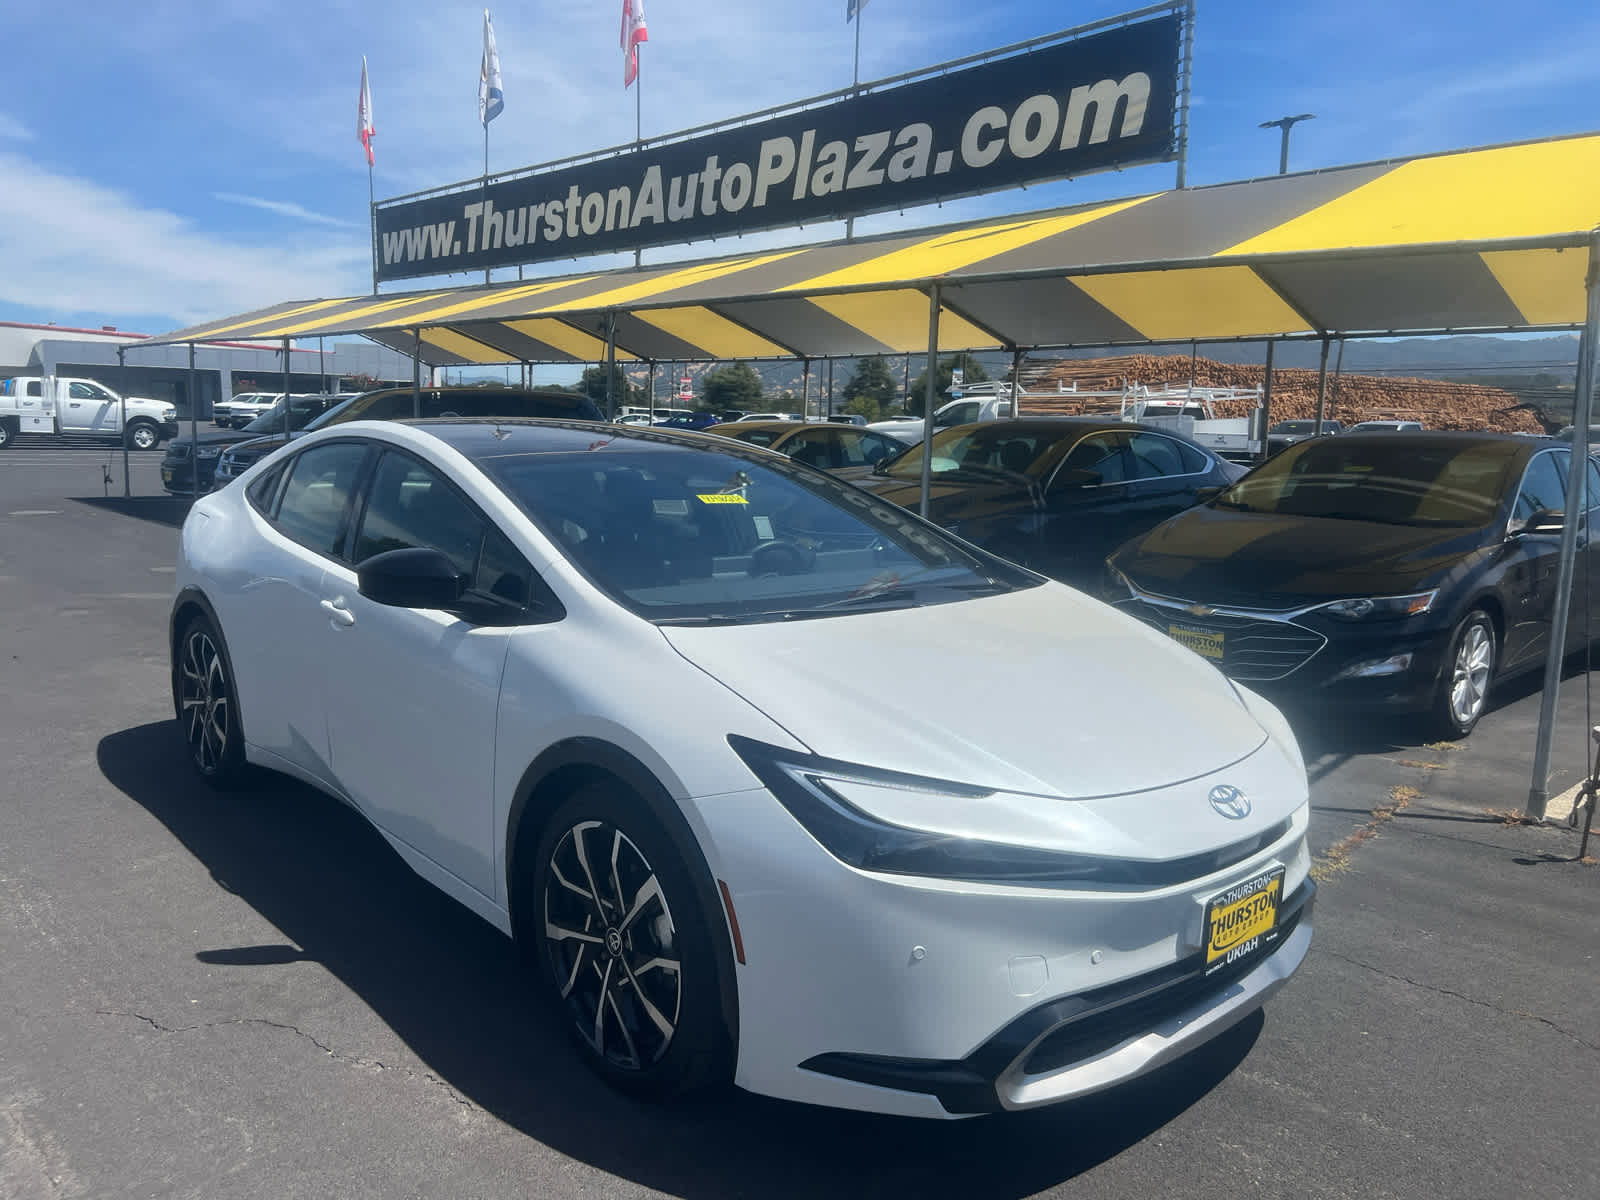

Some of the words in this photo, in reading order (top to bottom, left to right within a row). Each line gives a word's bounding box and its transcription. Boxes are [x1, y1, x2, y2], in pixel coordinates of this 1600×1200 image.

[382, 71, 1151, 265] www.ThurstonAutoPlaza.com
[1227, 875, 1270, 903] THURSTON
[1209, 889, 1278, 944] THURSTON
[1227, 937, 1258, 963] UKIAH
